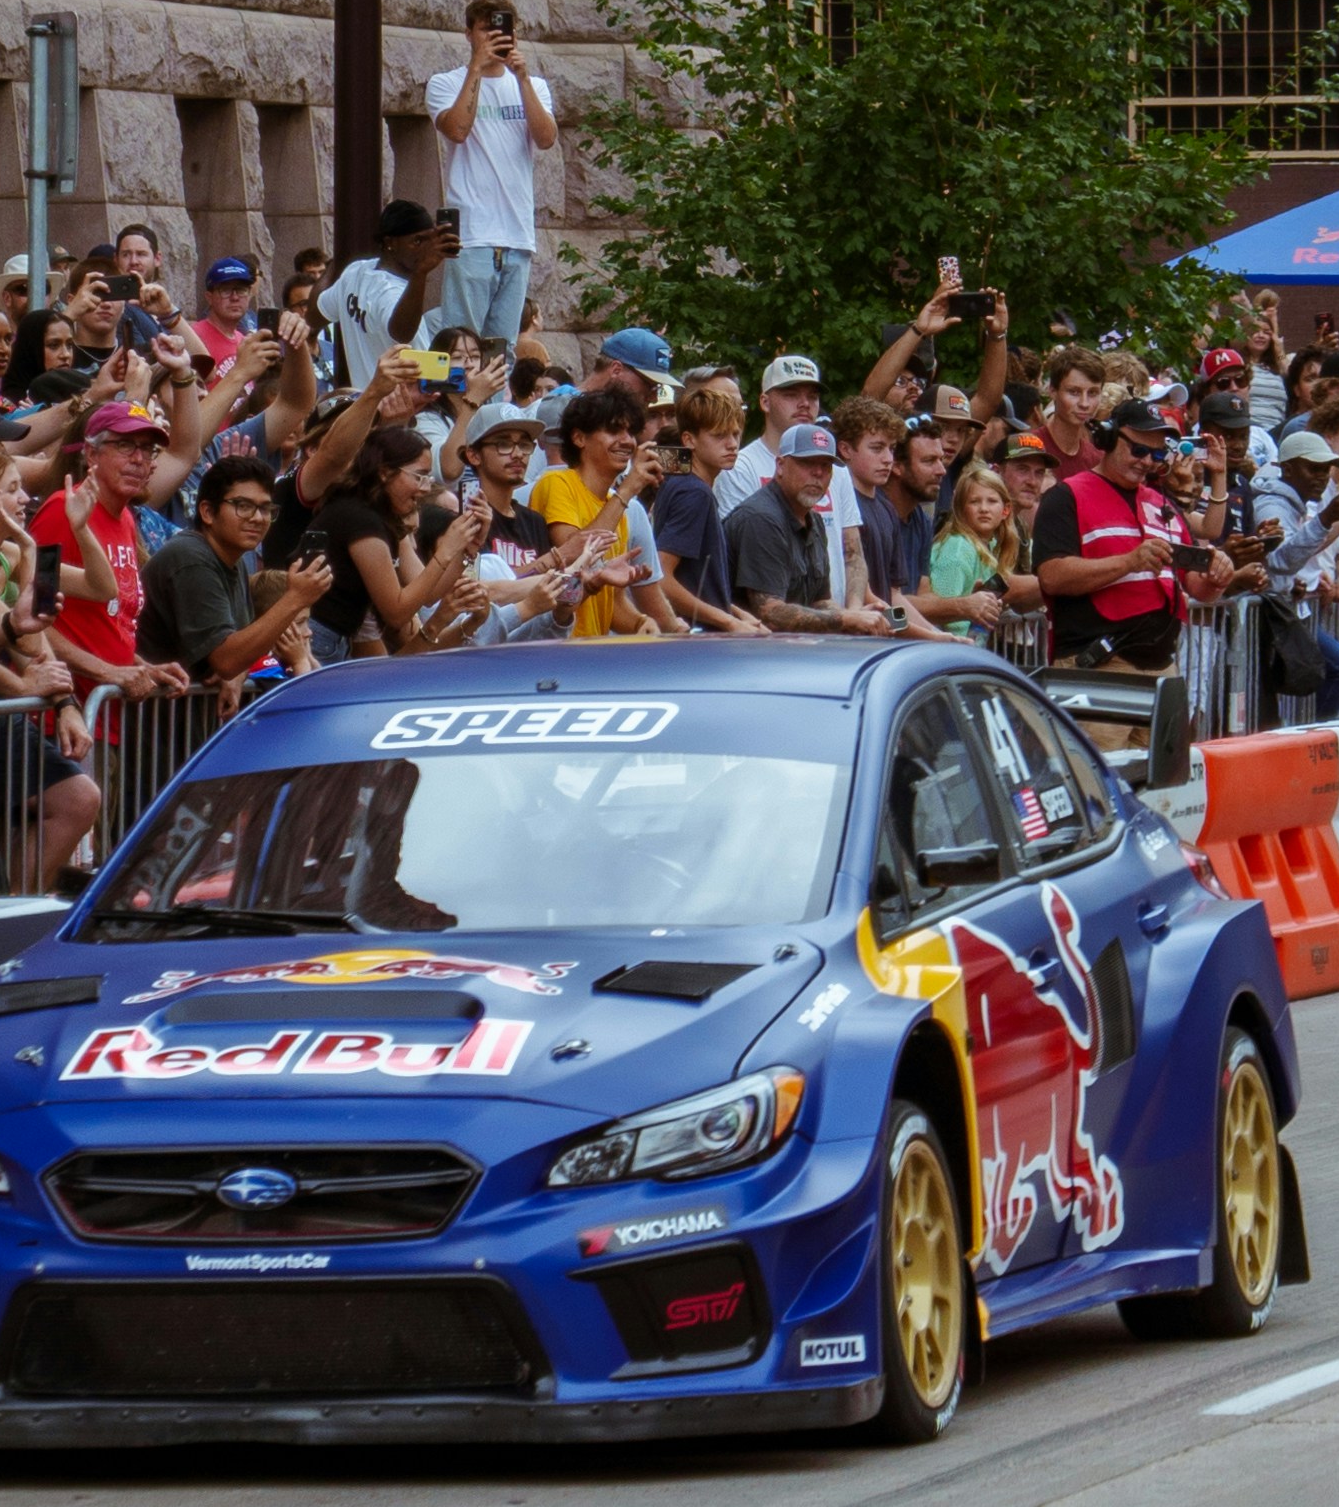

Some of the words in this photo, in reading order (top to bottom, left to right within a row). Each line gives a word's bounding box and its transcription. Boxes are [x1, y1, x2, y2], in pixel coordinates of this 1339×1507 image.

[493, 538, 538, 567] NIKE
[377, 706, 671, 745] SPEED
[981, 697, 1031, 784] 41
[62, 1026, 311, 1079] Red
[295, 1018, 533, 1075] Bull
[614, 1210, 724, 1246] YOKOHAMA
[186, 1253, 330, 1272] VermontSportsCar
[804, 1340, 861, 1360] MOTUL
